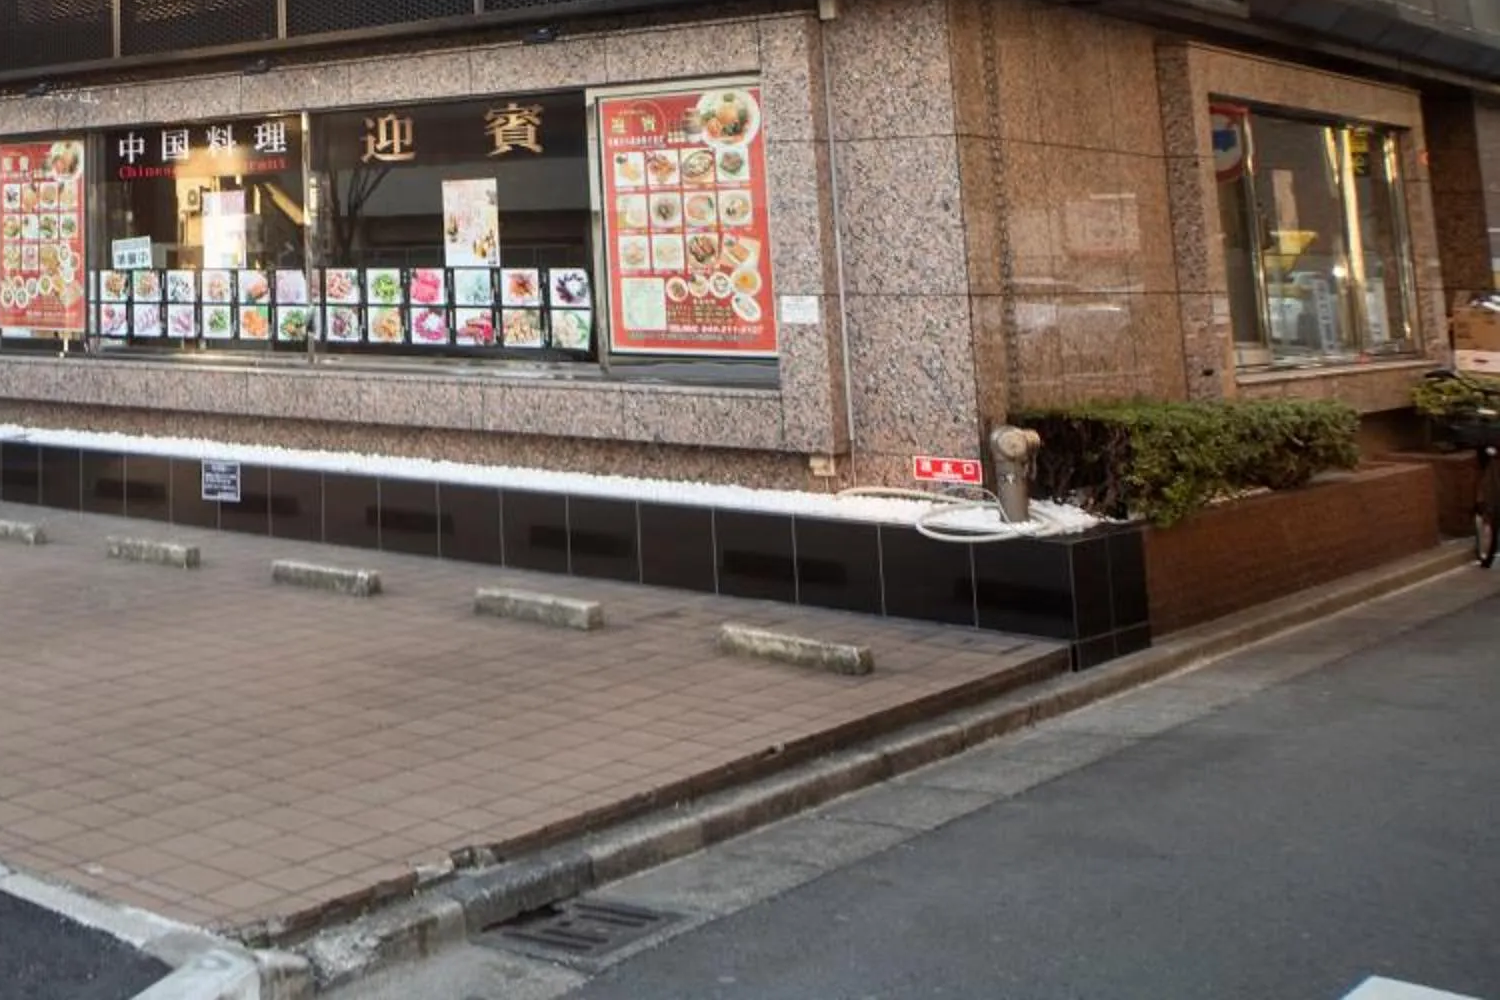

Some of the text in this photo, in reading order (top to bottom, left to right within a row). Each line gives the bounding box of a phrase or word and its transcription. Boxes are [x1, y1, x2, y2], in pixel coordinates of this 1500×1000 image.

[118, 121, 288, 165] 中国料理
[360, 102, 545, 164] 迎賓
